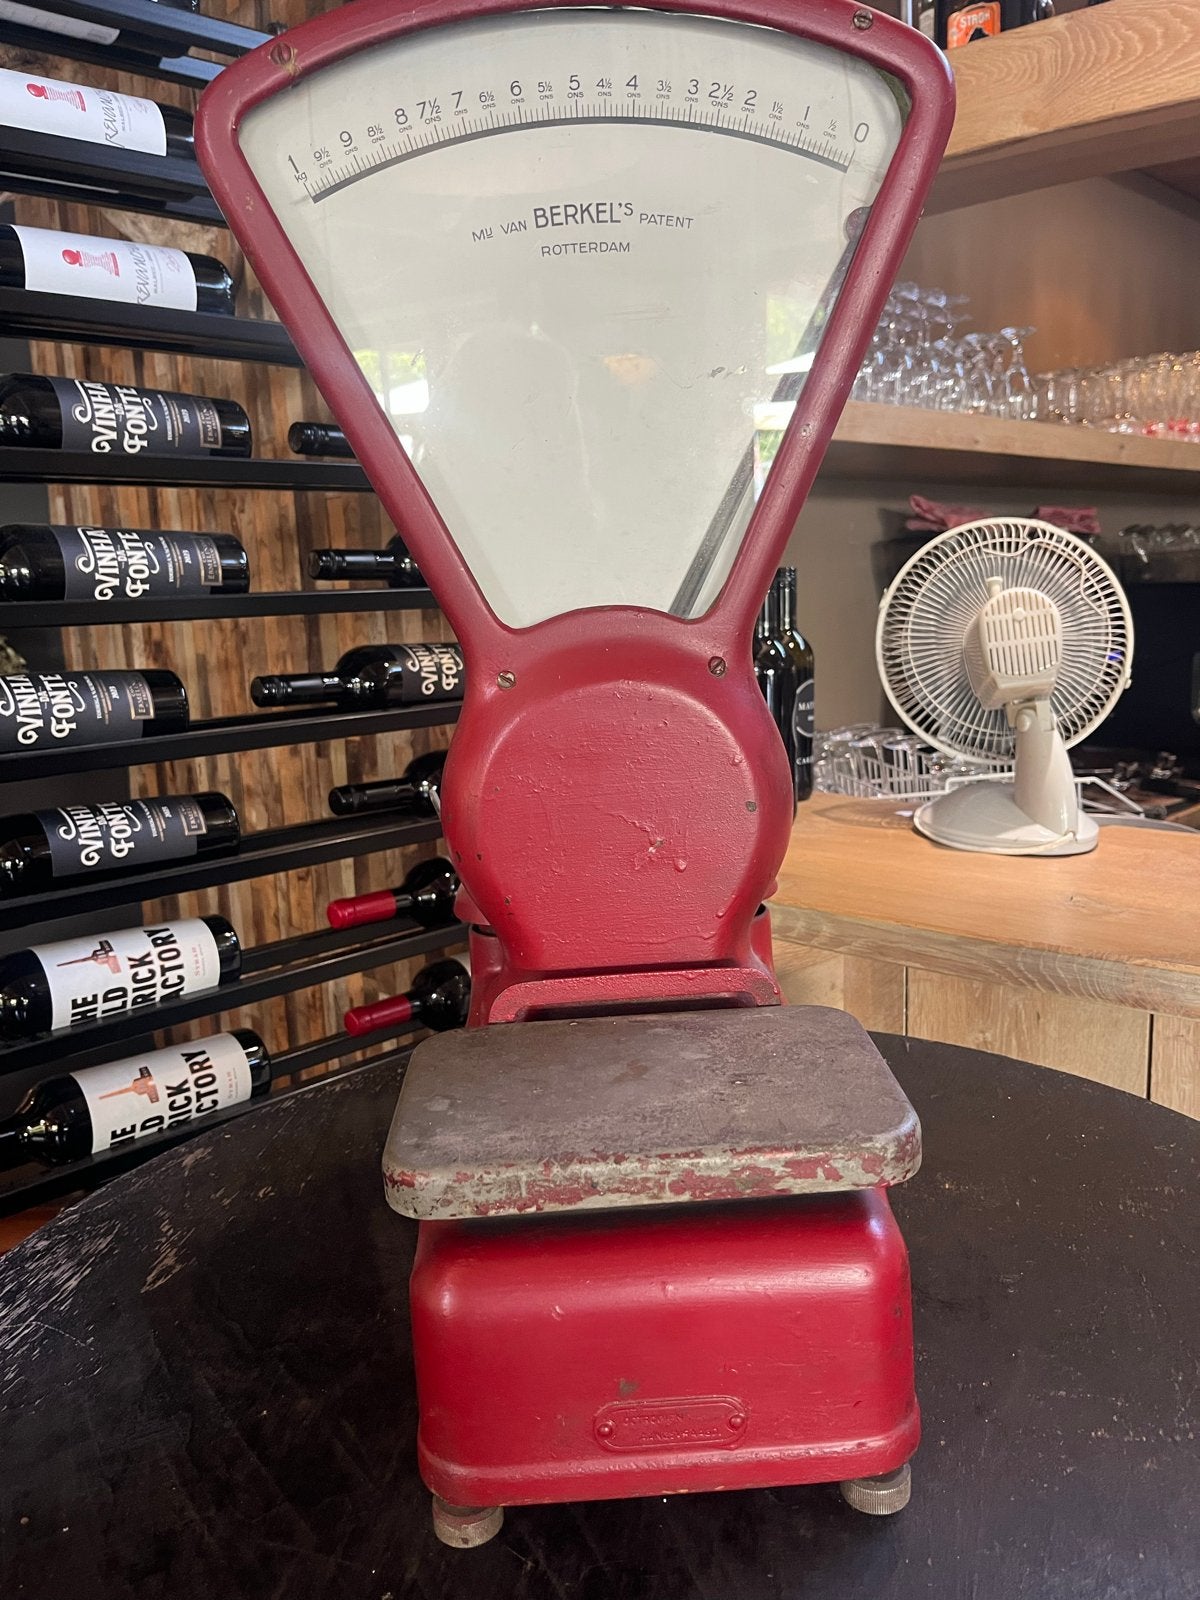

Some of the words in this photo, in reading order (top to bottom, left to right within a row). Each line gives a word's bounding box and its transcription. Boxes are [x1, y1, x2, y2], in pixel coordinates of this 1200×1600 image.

[294, 171, 308, 183] kg
[567, 91, 585, 99] ONS
[710, 99, 729, 109] ONS
[740, 105, 755, 114] ONS
[768, 112, 783, 121] ONS
[339, 130, 353, 148] 9
[394, 108, 408, 125] 8
[451, 90, 463, 109] 7
[510, 80, 522, 97] 6
[568, 74, 581, 91] 5
[625, 74, 639, 91] 4
[687, 79, 699, 95] 3
[743, 89, 757, 107] 2
[853, 122, 870, 143] 0
[499, 219, 528, 236] VAN
[532, 201, 635, 230] BERKEL'S
[638, 212, 695, 230] PATENT
[540, 241, 632, 258] ROTTERDAM
[84, 382, 117, 453] VINHA
[114, 386, 148, 454] FONTE
[86, 529, 120, 601] VINHA
[117, 531, 150, 598] FONTE
[5, 674, 44, 745] VINHA
[39, 674, 77, 738] FONTE
[127, 952, 158, 1007] RICK
[143, 927, 185, 1002] ACTORY
[70, 994, 98, 1027] HE
[102, 986, 128, 1015] LD
[180, 1049, 219, 1114] CTORY
